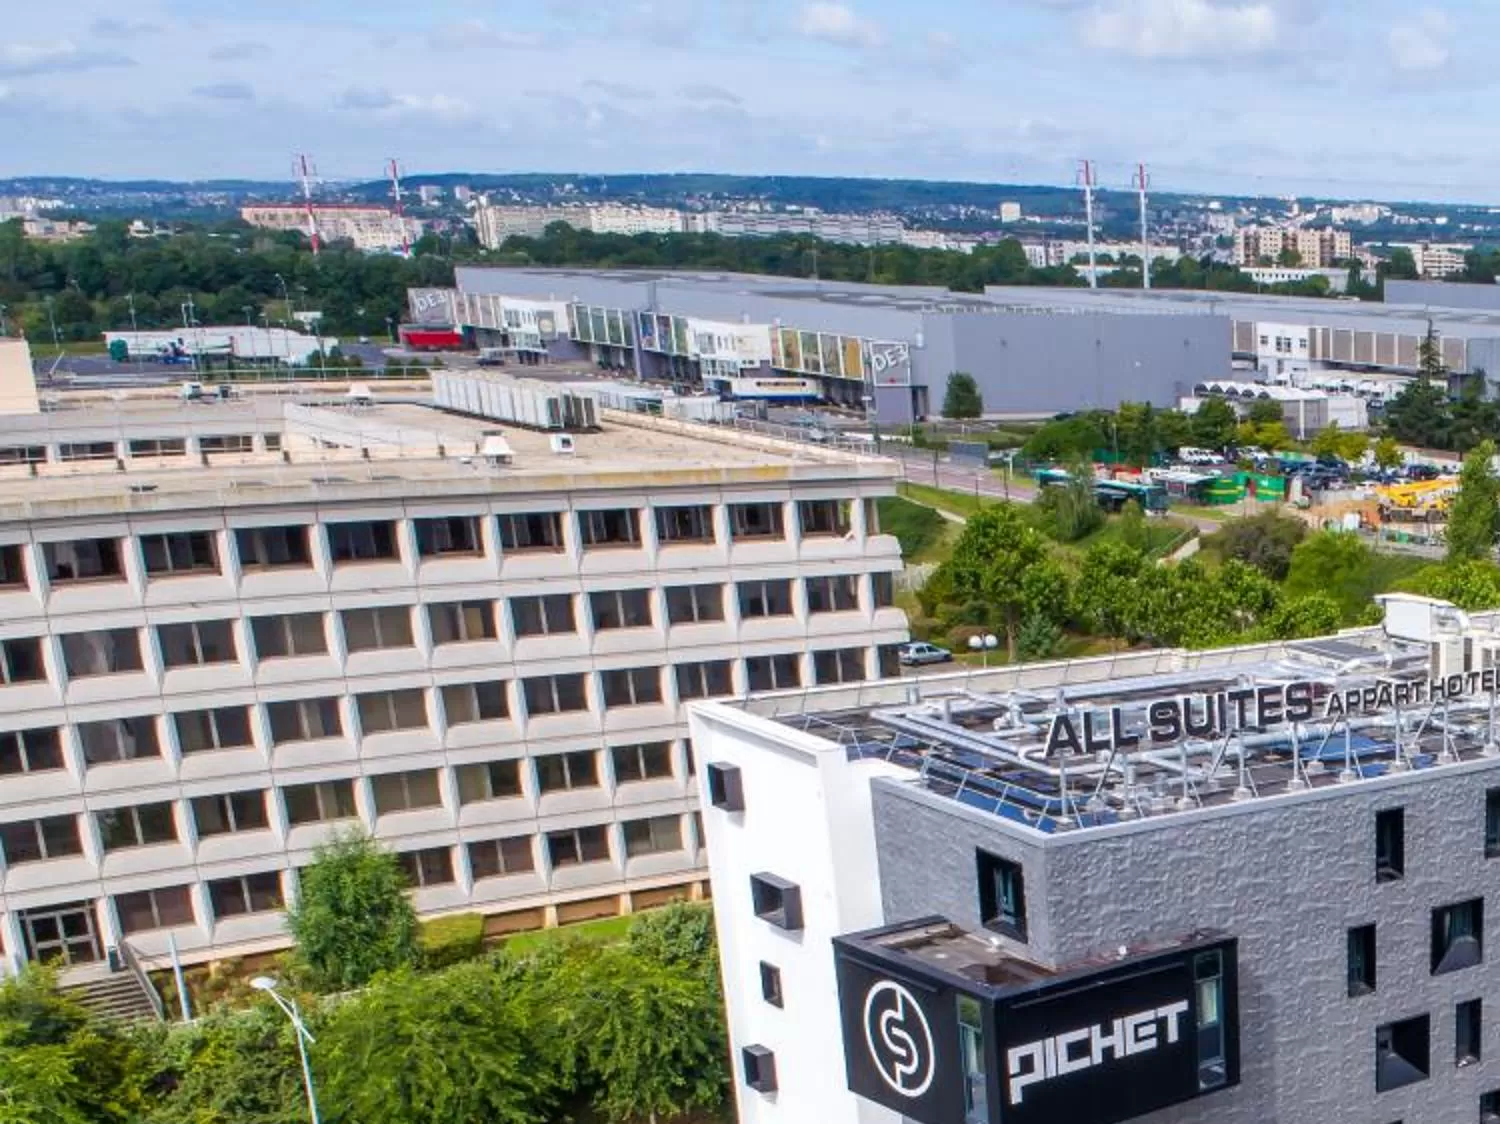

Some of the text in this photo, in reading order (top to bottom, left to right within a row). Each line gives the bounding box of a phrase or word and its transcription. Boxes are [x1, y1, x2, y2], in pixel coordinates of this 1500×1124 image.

[1045, 707, 1138, 757] ALL
[1149, 683, 1314, 741] SUITES
[1323, 676, 1424, 718] APPART
[1007, 1000, 1188, 1105] PICHET
